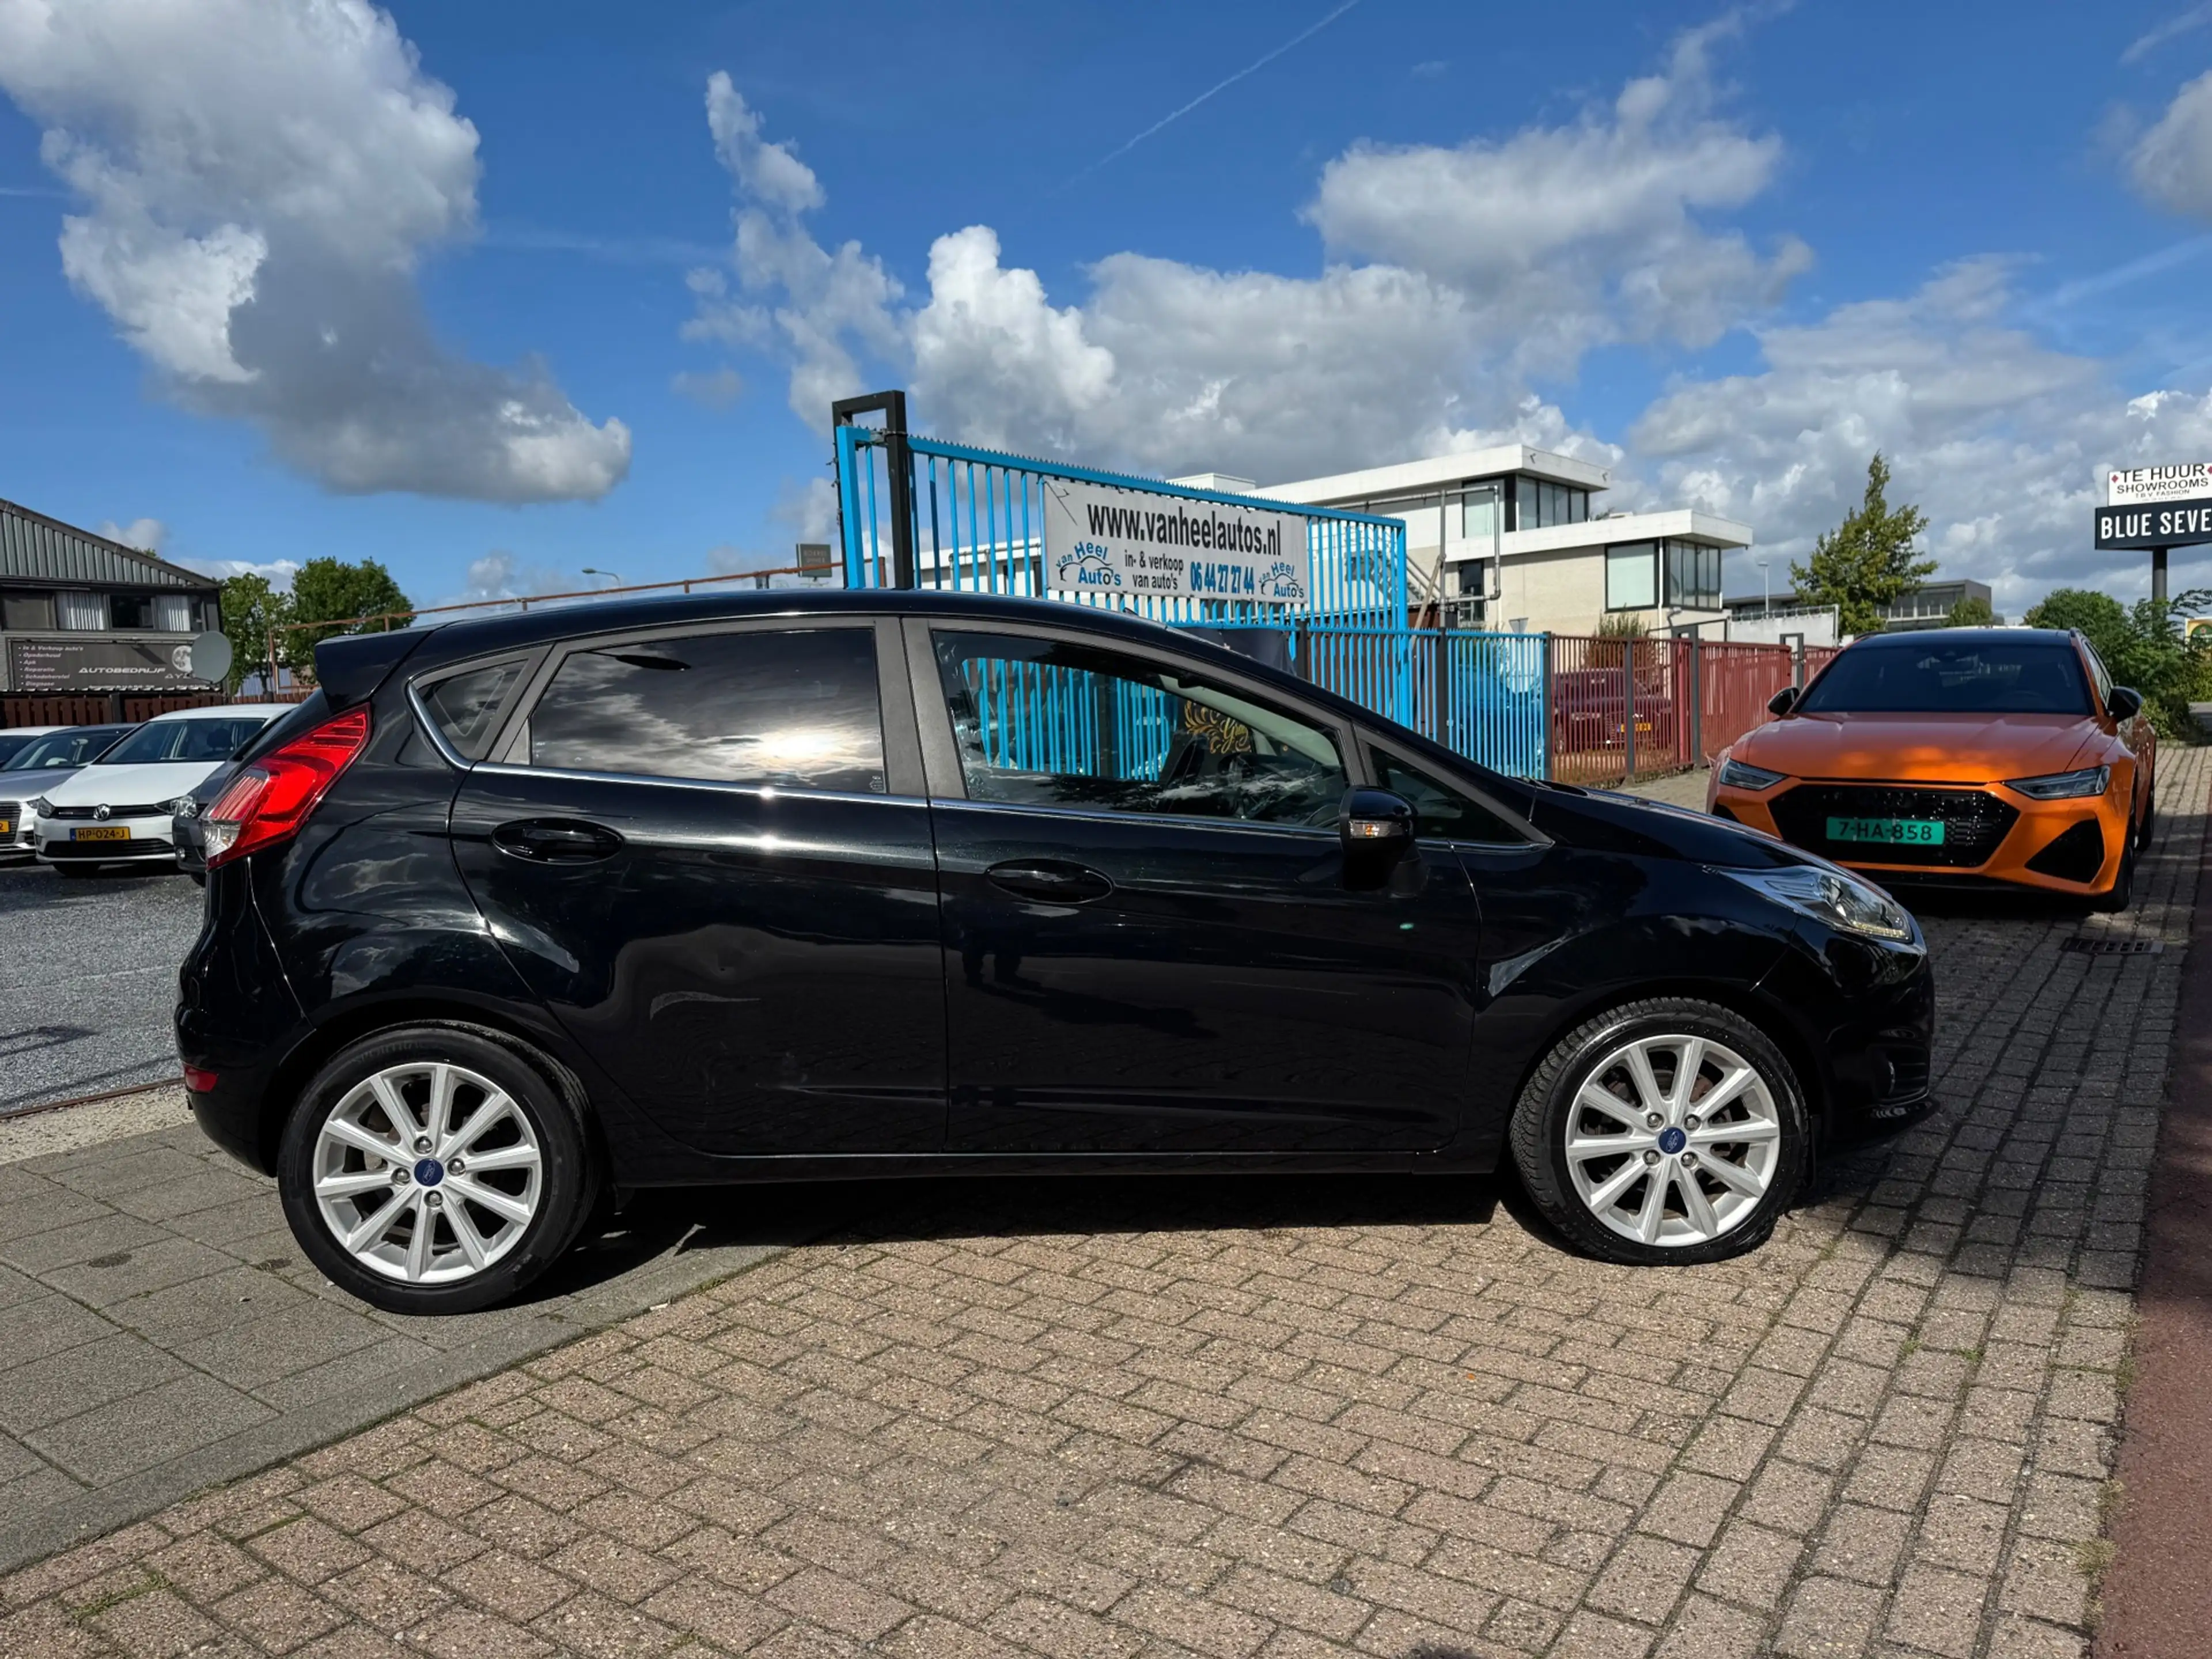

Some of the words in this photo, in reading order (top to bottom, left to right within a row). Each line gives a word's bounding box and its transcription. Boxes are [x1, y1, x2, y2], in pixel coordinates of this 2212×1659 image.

[2120, 469, 2143, 483] TE
[2151, 464, 2205, 480] HUUR
[2117, 478, 2209, 494] SHOWROOMS
[1087, 503, 1281, 556] www.vanheelautos.nl
[2101, 513, 2152, 539] BLUE
[1056, 553, 1073, 568] van
[1074, 541, 1108, 560] Heel
[1124, 550, 1137, 567] in-
[1139, 551, 1146, 568] &
[1149, 554, 1184, 575] verkoop
[1078, 567, 1122, 586] Auto's
[1190, 562, 1202, 592] 06
[1205, 563, 1216, 593] 44
[1218, 564, 1229, 593] 27
[1231, 565, 1241, 594] 27
[1244, 566, 1255, 594] 44
[1271, 561, 1295, 577] Heel
[1132, 574, 1149, 588] van
[1152, 573, 1178, 590] auto's
[1274, 583, 1304, 598] Auto's
[78, 830, 125, 839] HP-024-J
[1839, 821, 1932, 841] 7-HA-858
